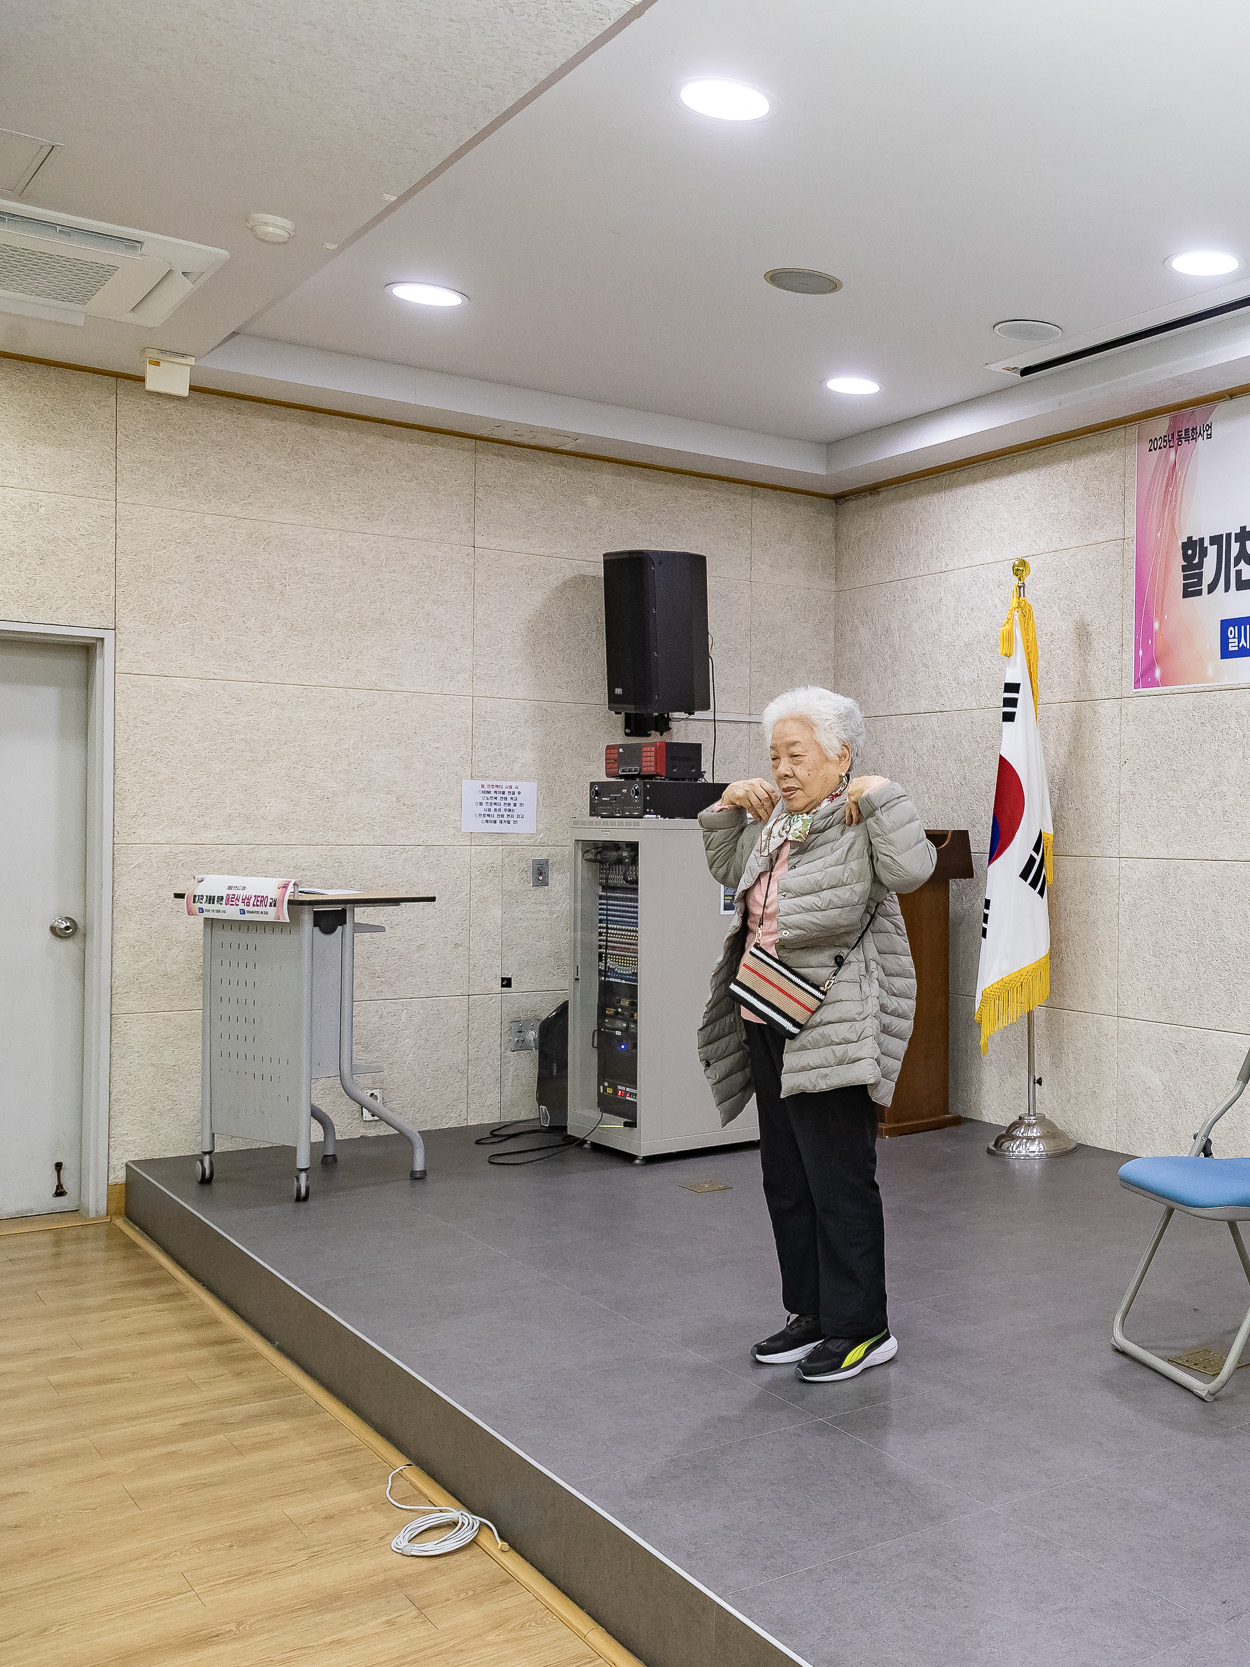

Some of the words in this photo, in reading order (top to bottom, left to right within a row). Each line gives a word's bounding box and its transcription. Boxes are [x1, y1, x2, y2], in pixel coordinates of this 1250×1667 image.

[1148, 431, 1175, 452] 2025년
[1176, 422, 1213, 447] 동특화사업
[1226, 624, 1250, 652] 일시
[252, 895, 268, 907] ZERO
